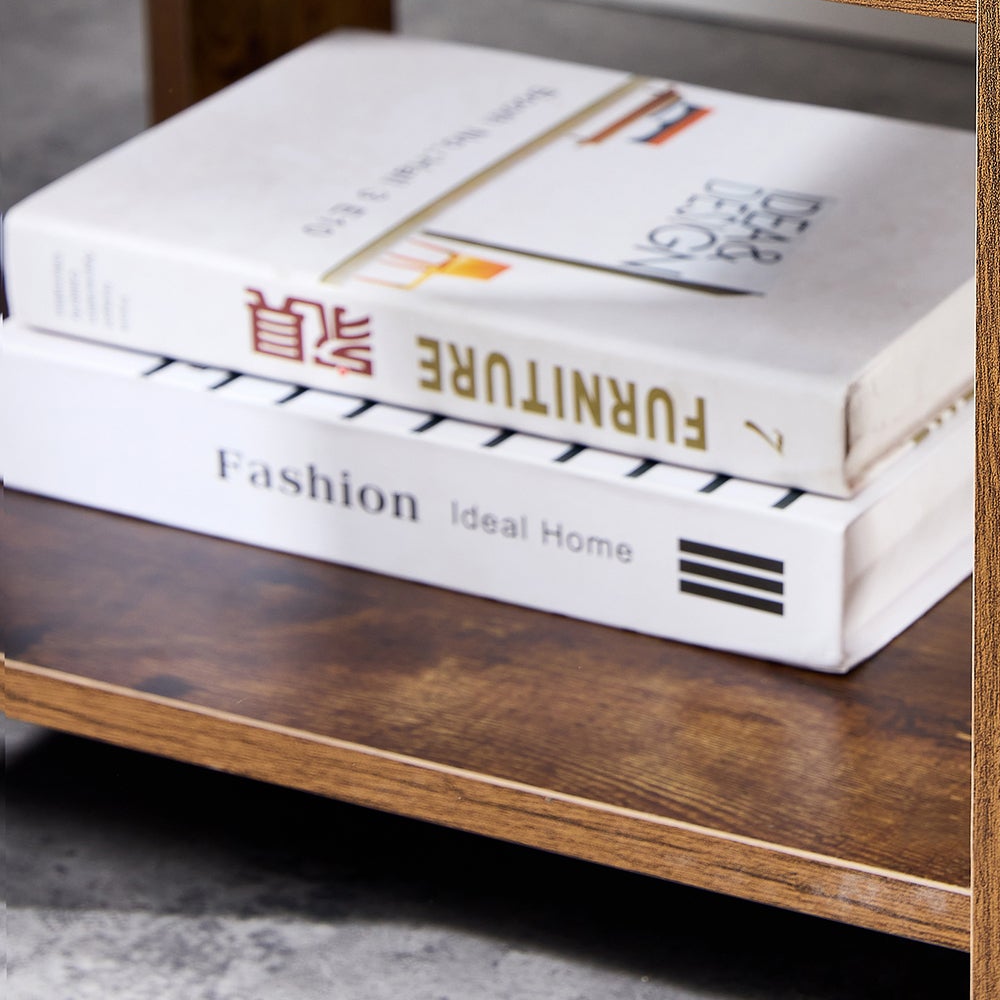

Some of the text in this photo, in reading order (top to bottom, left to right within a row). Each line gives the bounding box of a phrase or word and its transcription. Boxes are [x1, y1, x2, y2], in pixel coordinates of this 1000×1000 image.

[622, 178, 764, 278] DESIGN
[415, 334, 708, 451] FURNITURE
[217, 447, 634, 564] Fashion Ideal Home
